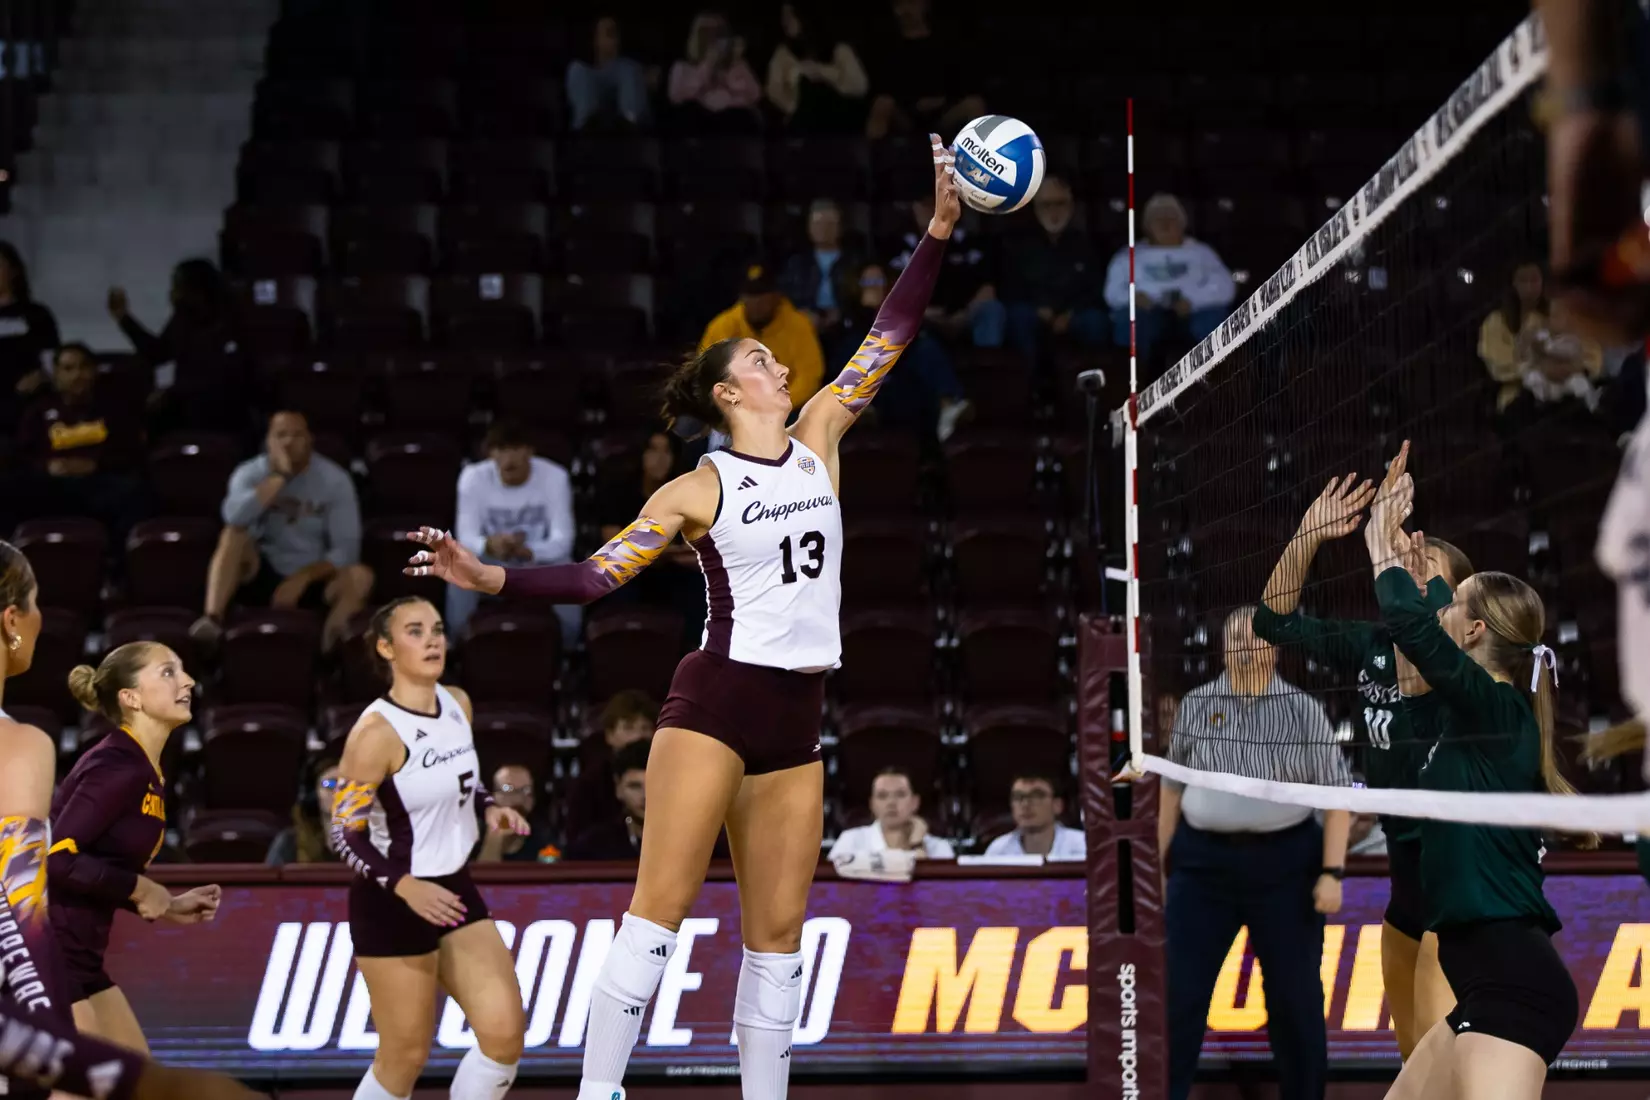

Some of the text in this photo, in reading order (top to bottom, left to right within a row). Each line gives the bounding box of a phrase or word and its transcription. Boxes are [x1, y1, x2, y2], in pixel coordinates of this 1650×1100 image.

[961, 137, 1005, 175] molten
[741, 495, 833, 525] Chippewas
[779, 530, 826, 585] 13
[1363, 707, 1393, 750] 10
[458, 770, 474, 808] 5
[1116, 963, 1139, 1028] sports
